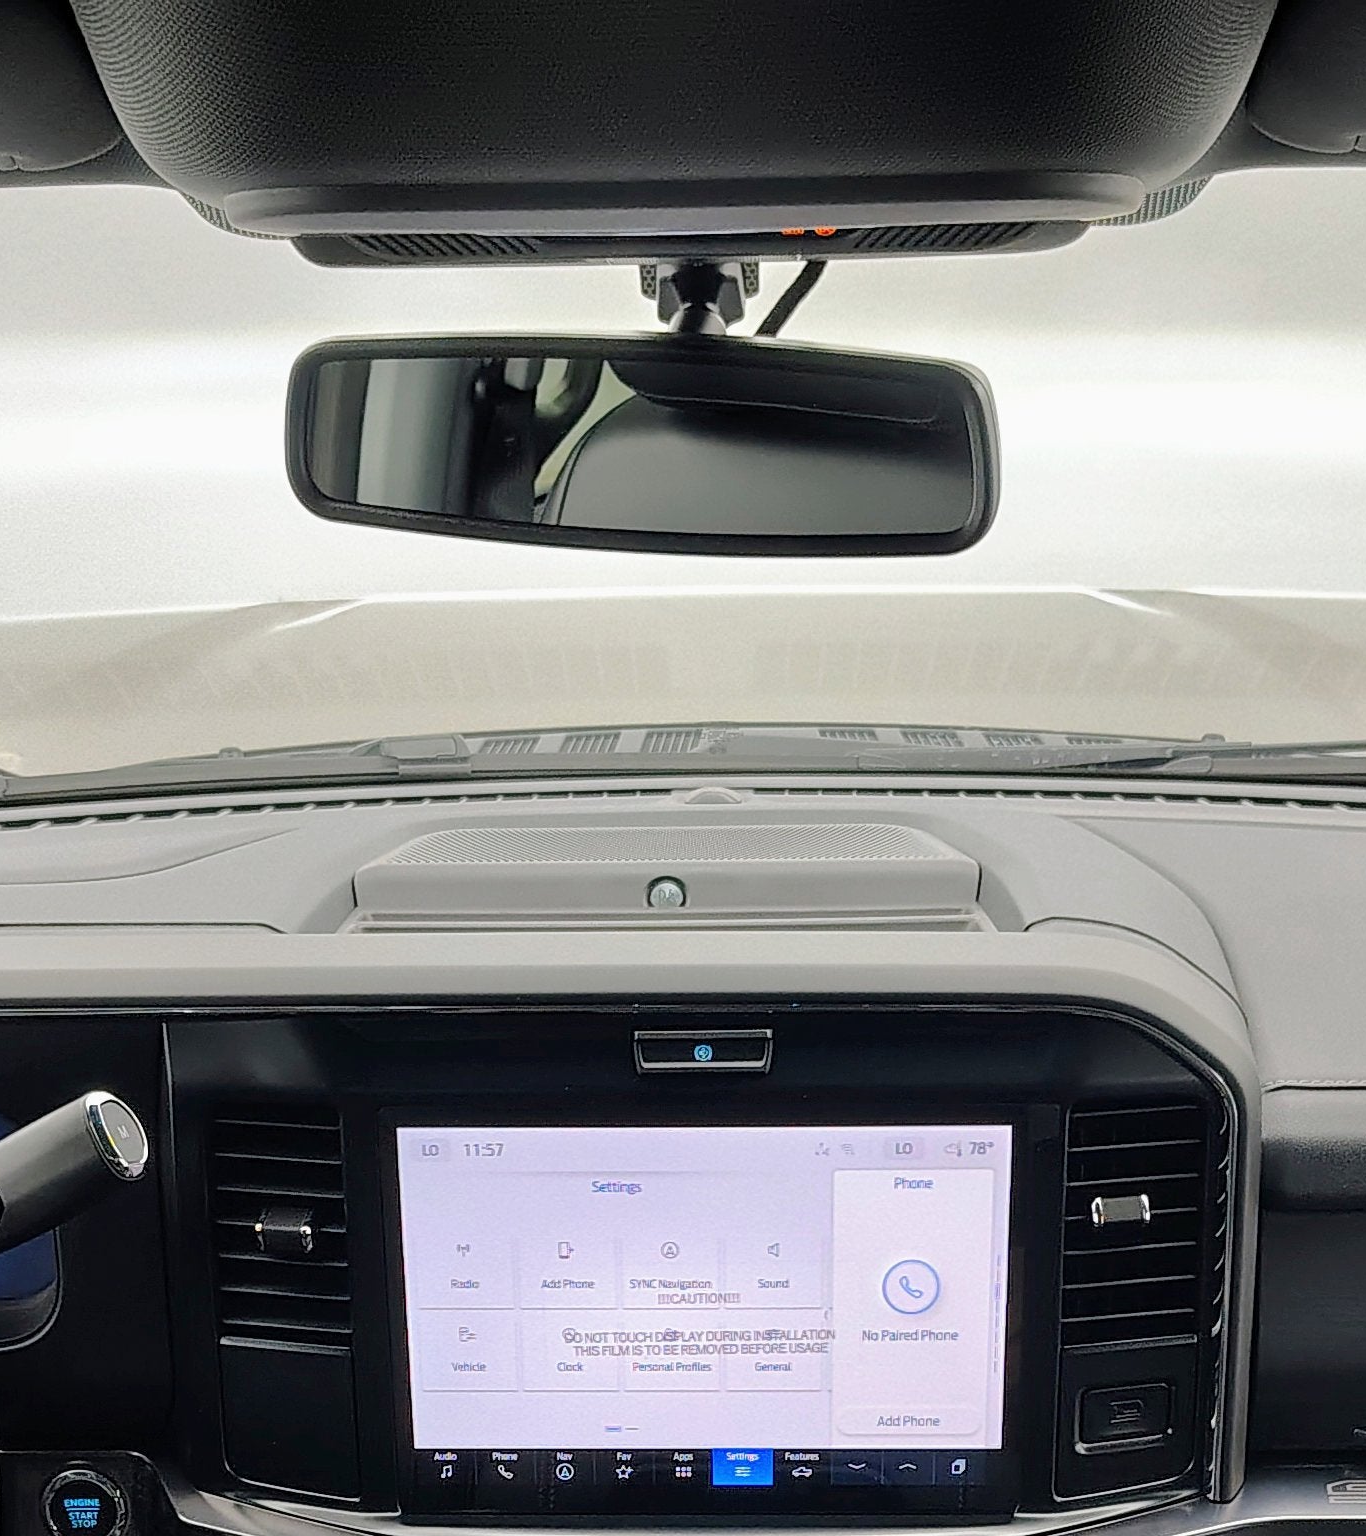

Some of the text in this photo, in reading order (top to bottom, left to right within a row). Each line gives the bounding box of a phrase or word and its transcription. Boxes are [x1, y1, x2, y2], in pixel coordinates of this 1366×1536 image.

[422, 1144, 439, 1156] LO
[895, 1142, 913, 1154] LO
[894, 1176, 934, 1189] Phone
[591, 1180, 642, 1196] Settings
[757, 1279, 790, 1289] Sound
[585, 1331, 609, 1343] NOT
[612, 1331, 652, 1343] TOUCH
[706, 1330, 752, 1342] DURING
[862, 1329, 959, 1341] No Paired Phone
[573, 1344, 601, 1356] THIS
[602, 1344, 630, 1356] FILM
[644, 1344, 661, 1356] TO
[663, 1344, 680, 1355] BE
[681, 1343, 739, 1355] REMOVED
[740, 1343, 787, 1355] BEFORE
[788, 1342, 829, 1354] USAGE
[451, 1362, 486, 1372] Vehicle
[632, 1362, 712, 1372] Personal Profiles
[754, 1362, 792, 1372] General
[877, 1416, 940, 1427] Add Phone
[434, 1452, 457, 1461] Audio
[492, 1452, 518, 1461] Phone
[556, 1452, 573, 1461] Nav
[617, 1452, 632, 1461] Fav
[673, 1452, 694, 1463] Apps
[726, 1452, 760, 1463] Settings
[785, 1452, 820, 1461] Features
[64, 1498, 100, 1507] ENGINE
[69, 1511, 98, 1520] START
[71, 1519, 98, 1528] STOP
